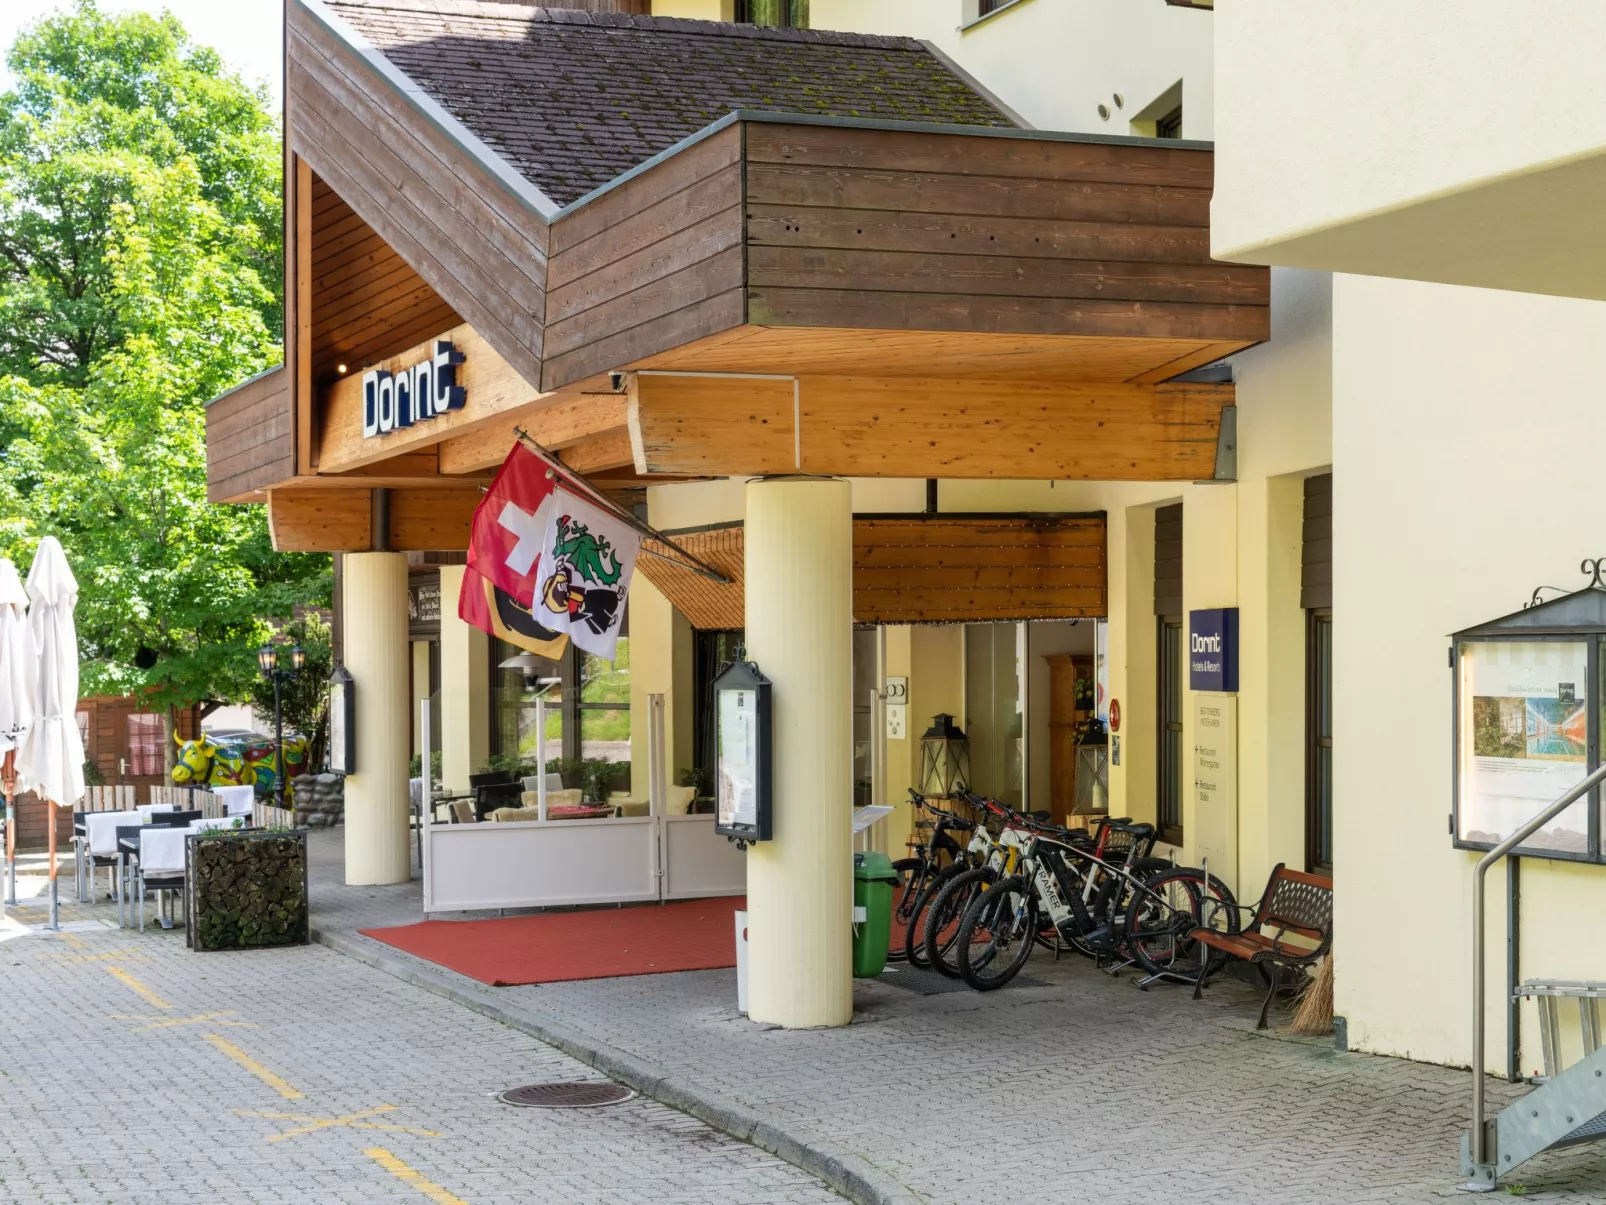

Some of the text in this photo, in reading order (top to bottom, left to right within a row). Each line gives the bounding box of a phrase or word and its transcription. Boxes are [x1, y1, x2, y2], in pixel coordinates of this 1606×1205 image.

[362, 340, 466, 439] Dorint
[1192, 632, 1220, 653] Dorint
[1192, 660, 1204, 672] Hotels
[1207, 660, 1221, 673] Resorts
[1199, 745, 1217, 757] Restaurant
[1199, 779, 1217, 792] Restaurant
